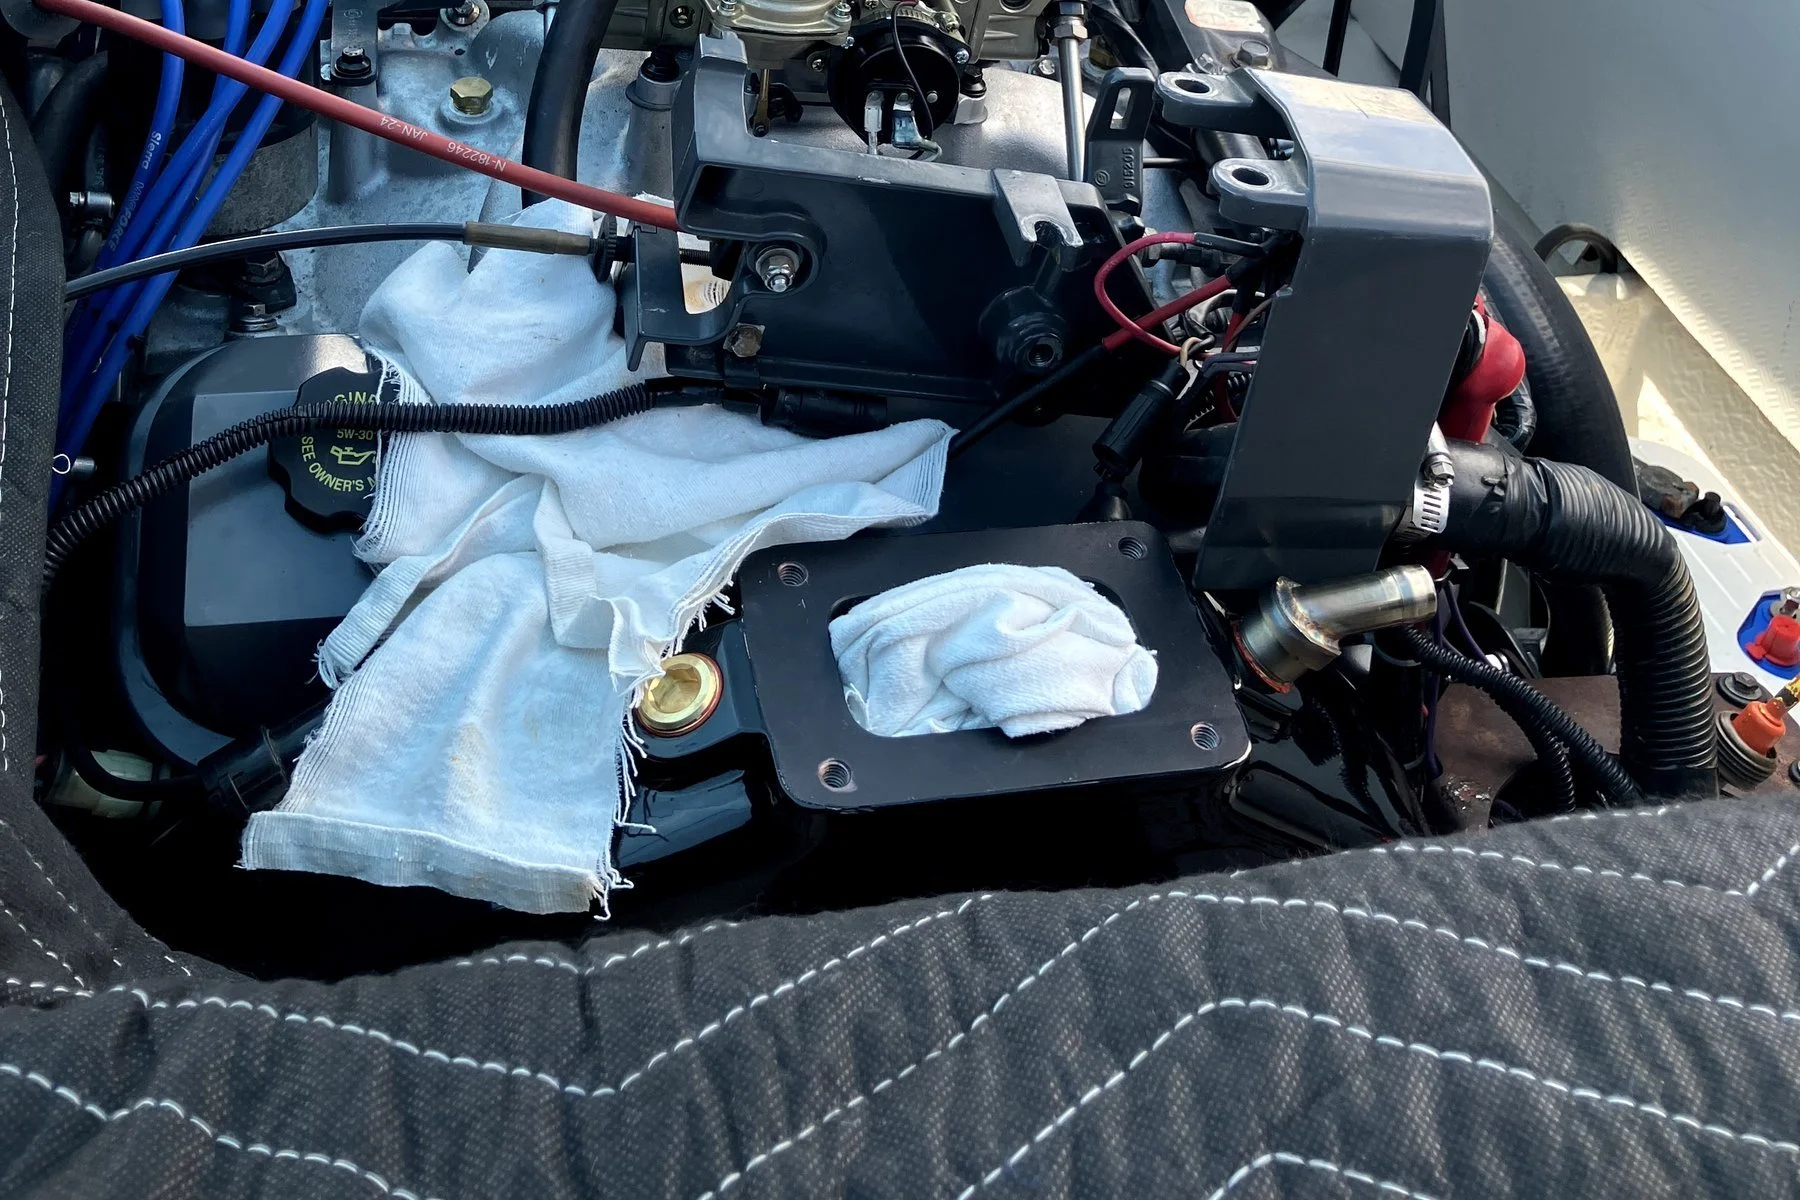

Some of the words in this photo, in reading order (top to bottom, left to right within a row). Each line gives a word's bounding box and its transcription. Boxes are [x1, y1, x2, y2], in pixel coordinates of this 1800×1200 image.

[142, 131, 162, 170] Sierra
[447, 142, 506, 171] N-182246
[301, 436, 317, 462] SEE
[336, 428, 374, 441] 5W-30
[308, 462, 365, 492] OWNER'S
